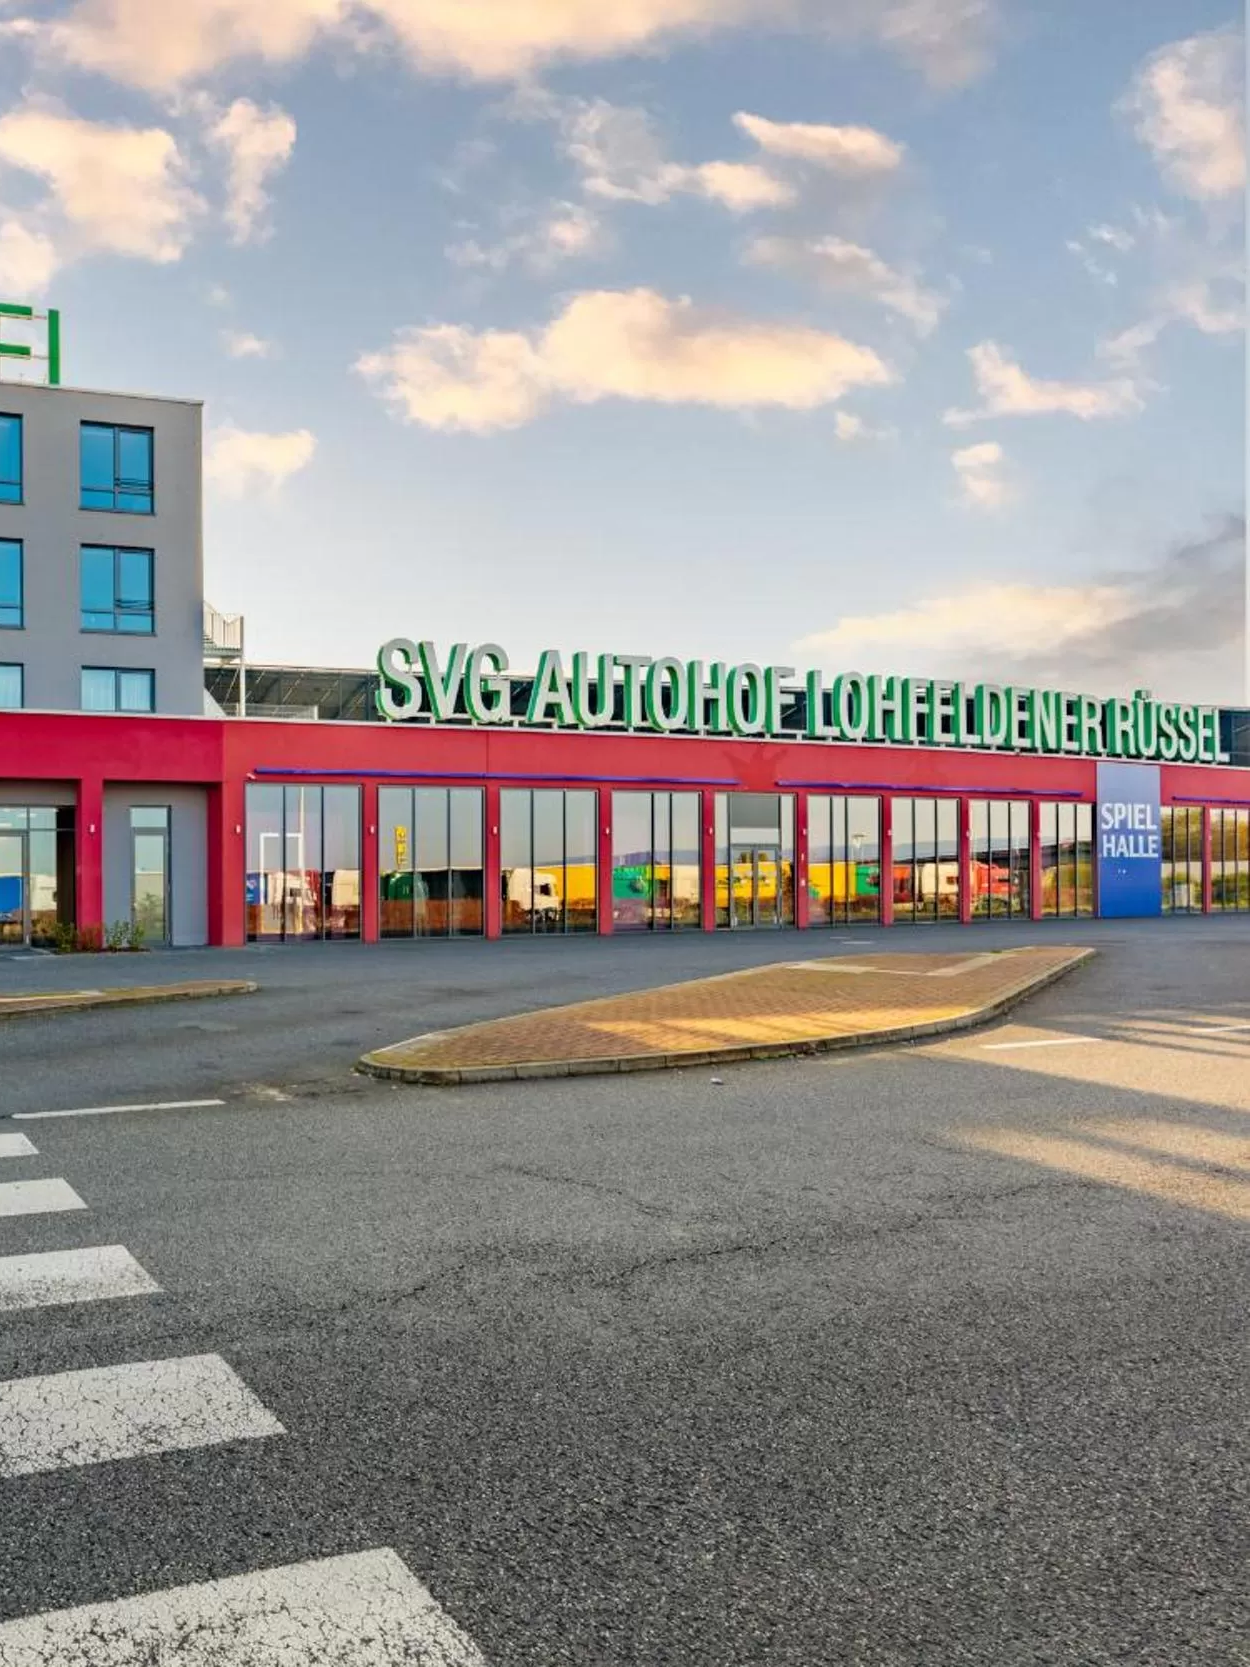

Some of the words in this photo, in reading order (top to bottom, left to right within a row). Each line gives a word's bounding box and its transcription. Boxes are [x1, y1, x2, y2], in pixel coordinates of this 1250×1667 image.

[375, 637, 509, 723] SVG
[525, 649, 795, 735] AUTOHOF
[806, 670, 1107, 755] LOHFELDENER
[1106, 689, 1230, 762] RÜSSEL
[1101, 803, 1157, 829] SPIEL
[1102, 834, 1159, 857] HALLE
